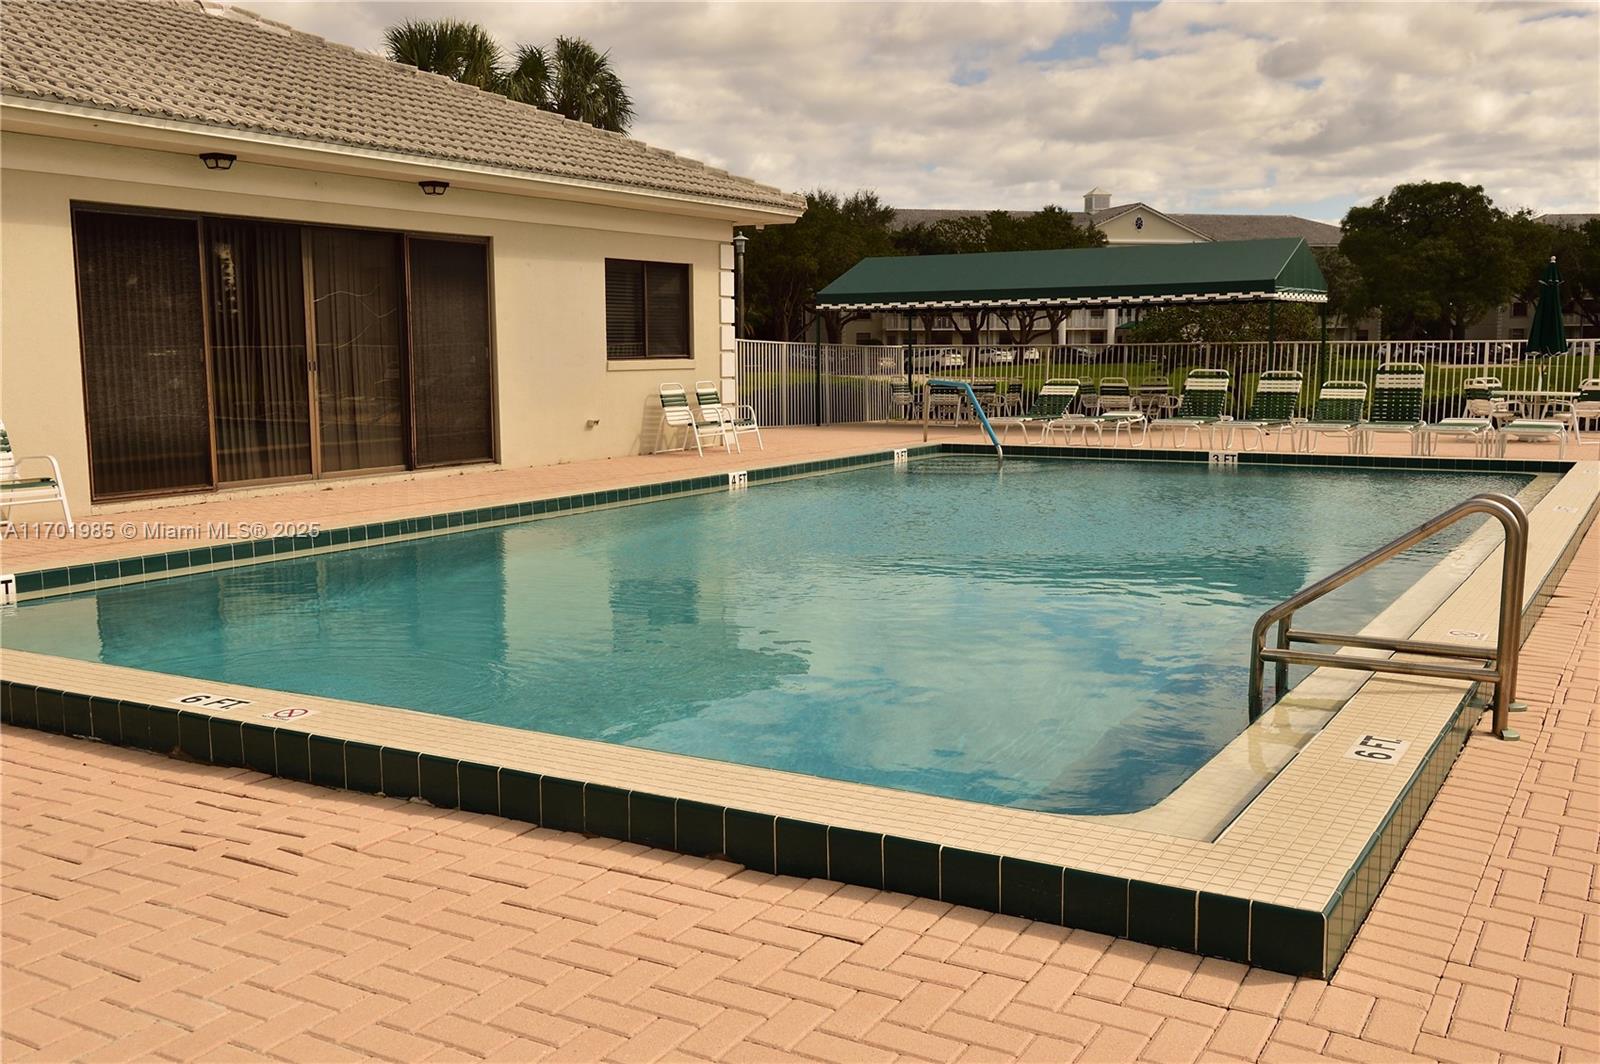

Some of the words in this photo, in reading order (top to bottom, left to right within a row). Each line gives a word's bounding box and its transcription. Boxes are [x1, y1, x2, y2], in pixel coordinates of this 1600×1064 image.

[1212, 454, 1219, 463] 3
[1224, 454, 1236, 463] FT
[731, 474, 736, 484] 4
[739, 473, 747, 483] FT
[0, 579, 13, 595] T
[180, 695, 211, 704] 6
[1354, 750, 1392, 760] 6
